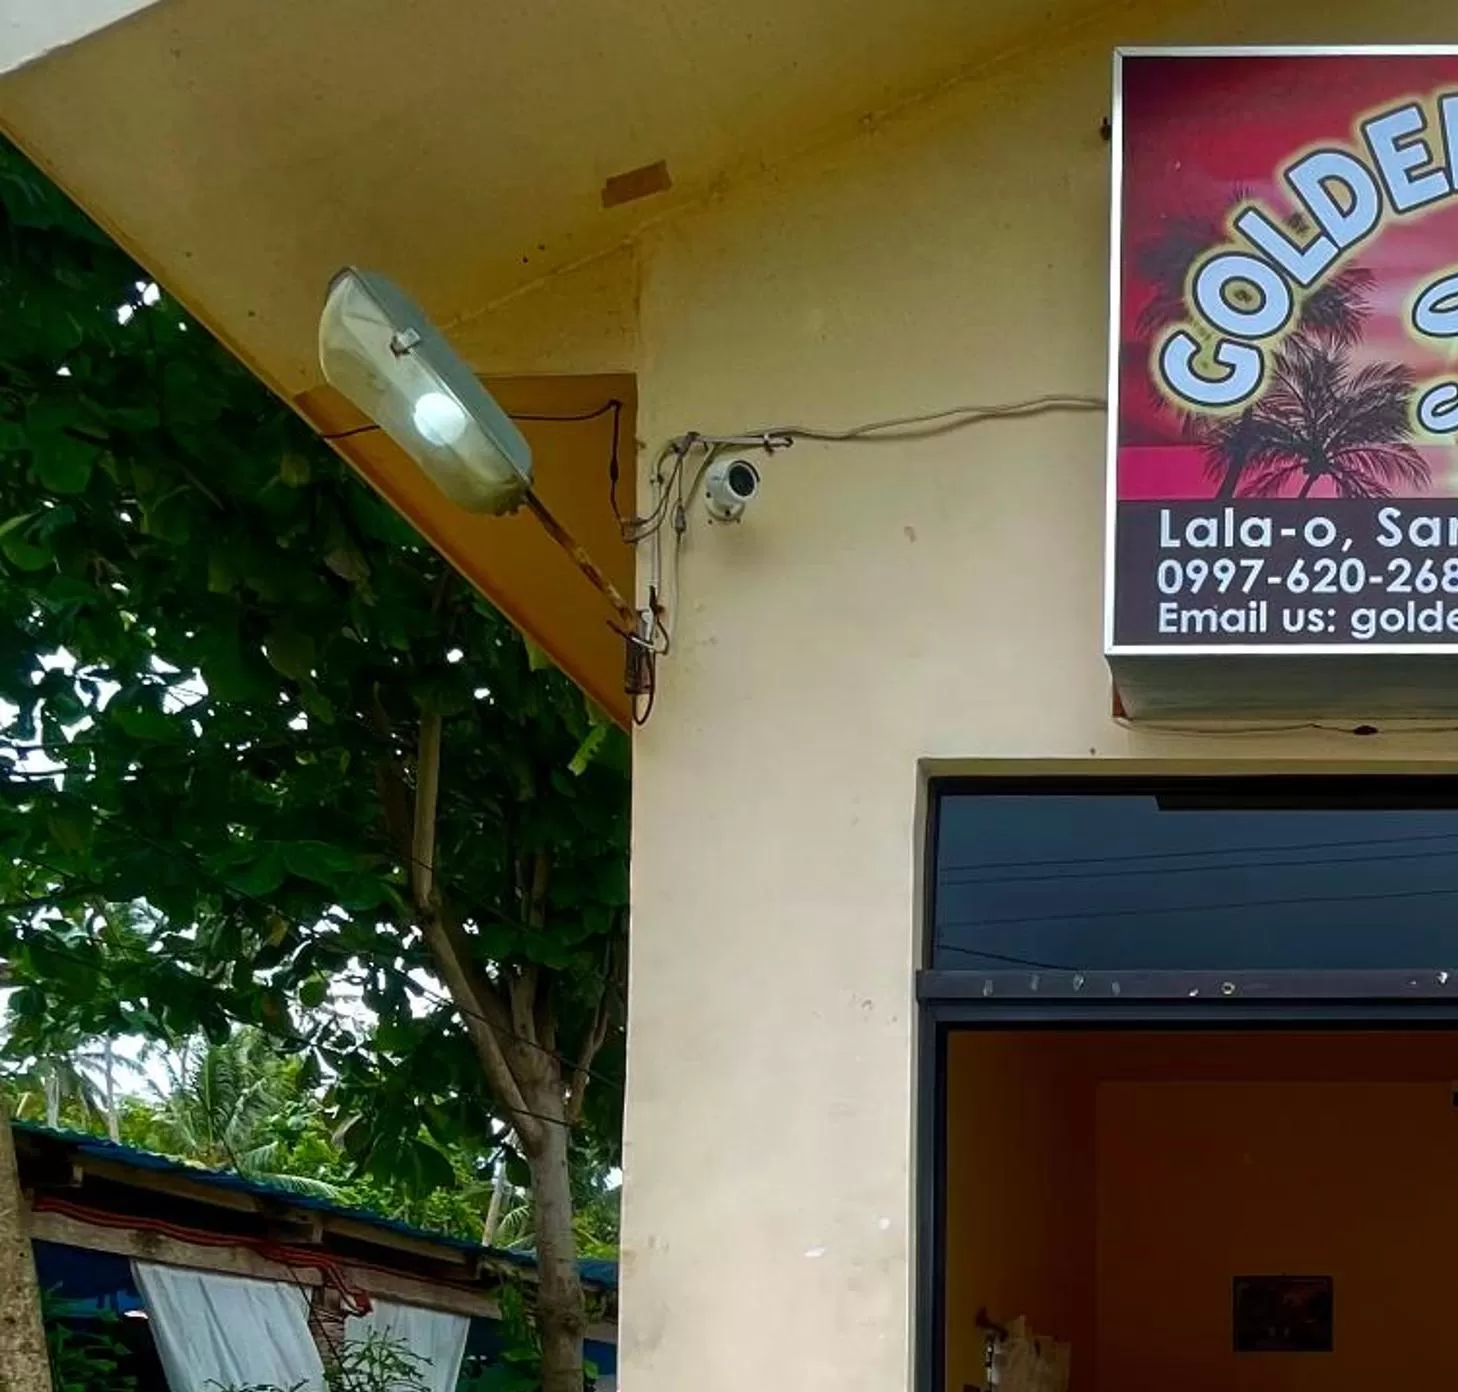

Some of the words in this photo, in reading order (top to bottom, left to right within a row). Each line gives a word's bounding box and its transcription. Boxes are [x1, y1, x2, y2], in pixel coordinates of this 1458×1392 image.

[1160, 507, 1353, 552] Lala-o,
[1158, 600, 1268, 634] Email
[1282, 607, 1337, 634] us:
